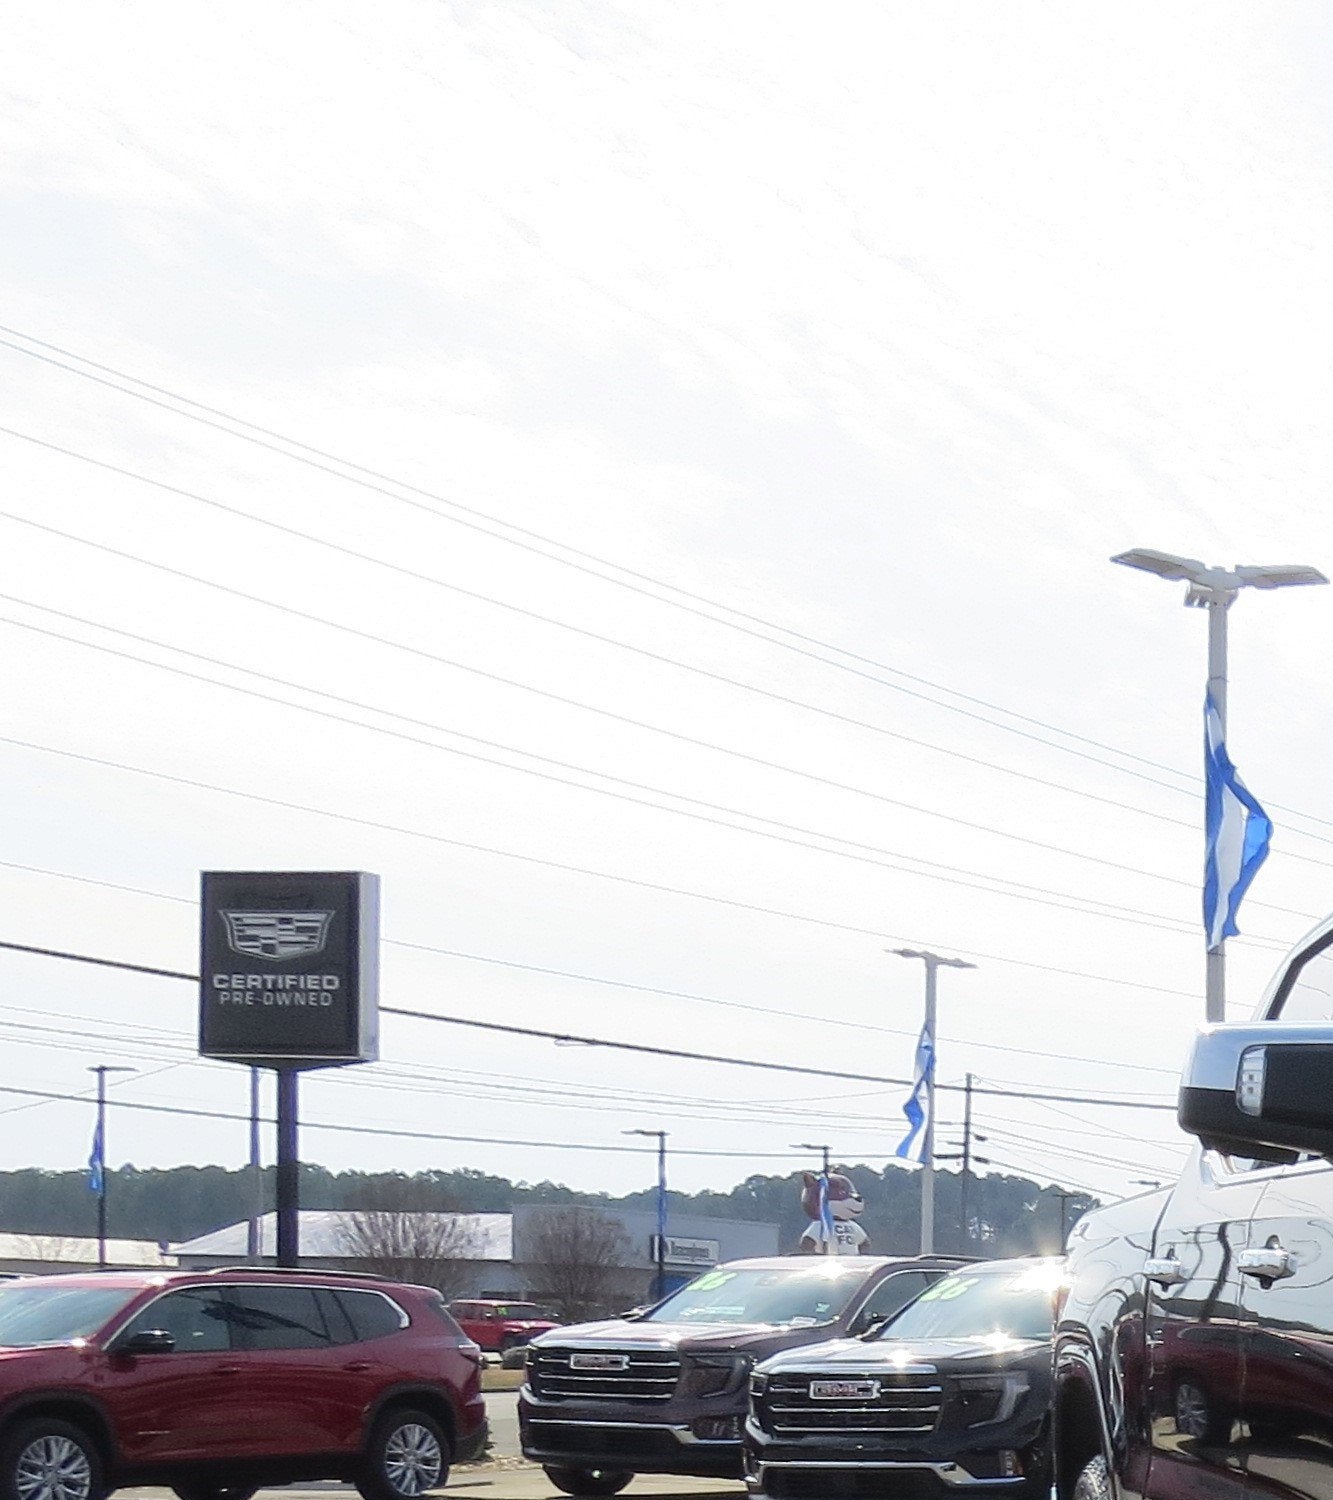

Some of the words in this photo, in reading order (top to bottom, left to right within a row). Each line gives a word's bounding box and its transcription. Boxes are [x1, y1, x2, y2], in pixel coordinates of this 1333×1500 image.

[212, 974, 340, 990] CERTIFIED
[220, 991, 333, 1006] PRE-OWNED
[687, 1271, 738, 1292] 26
[920, 1277, 980, 1302] 26
